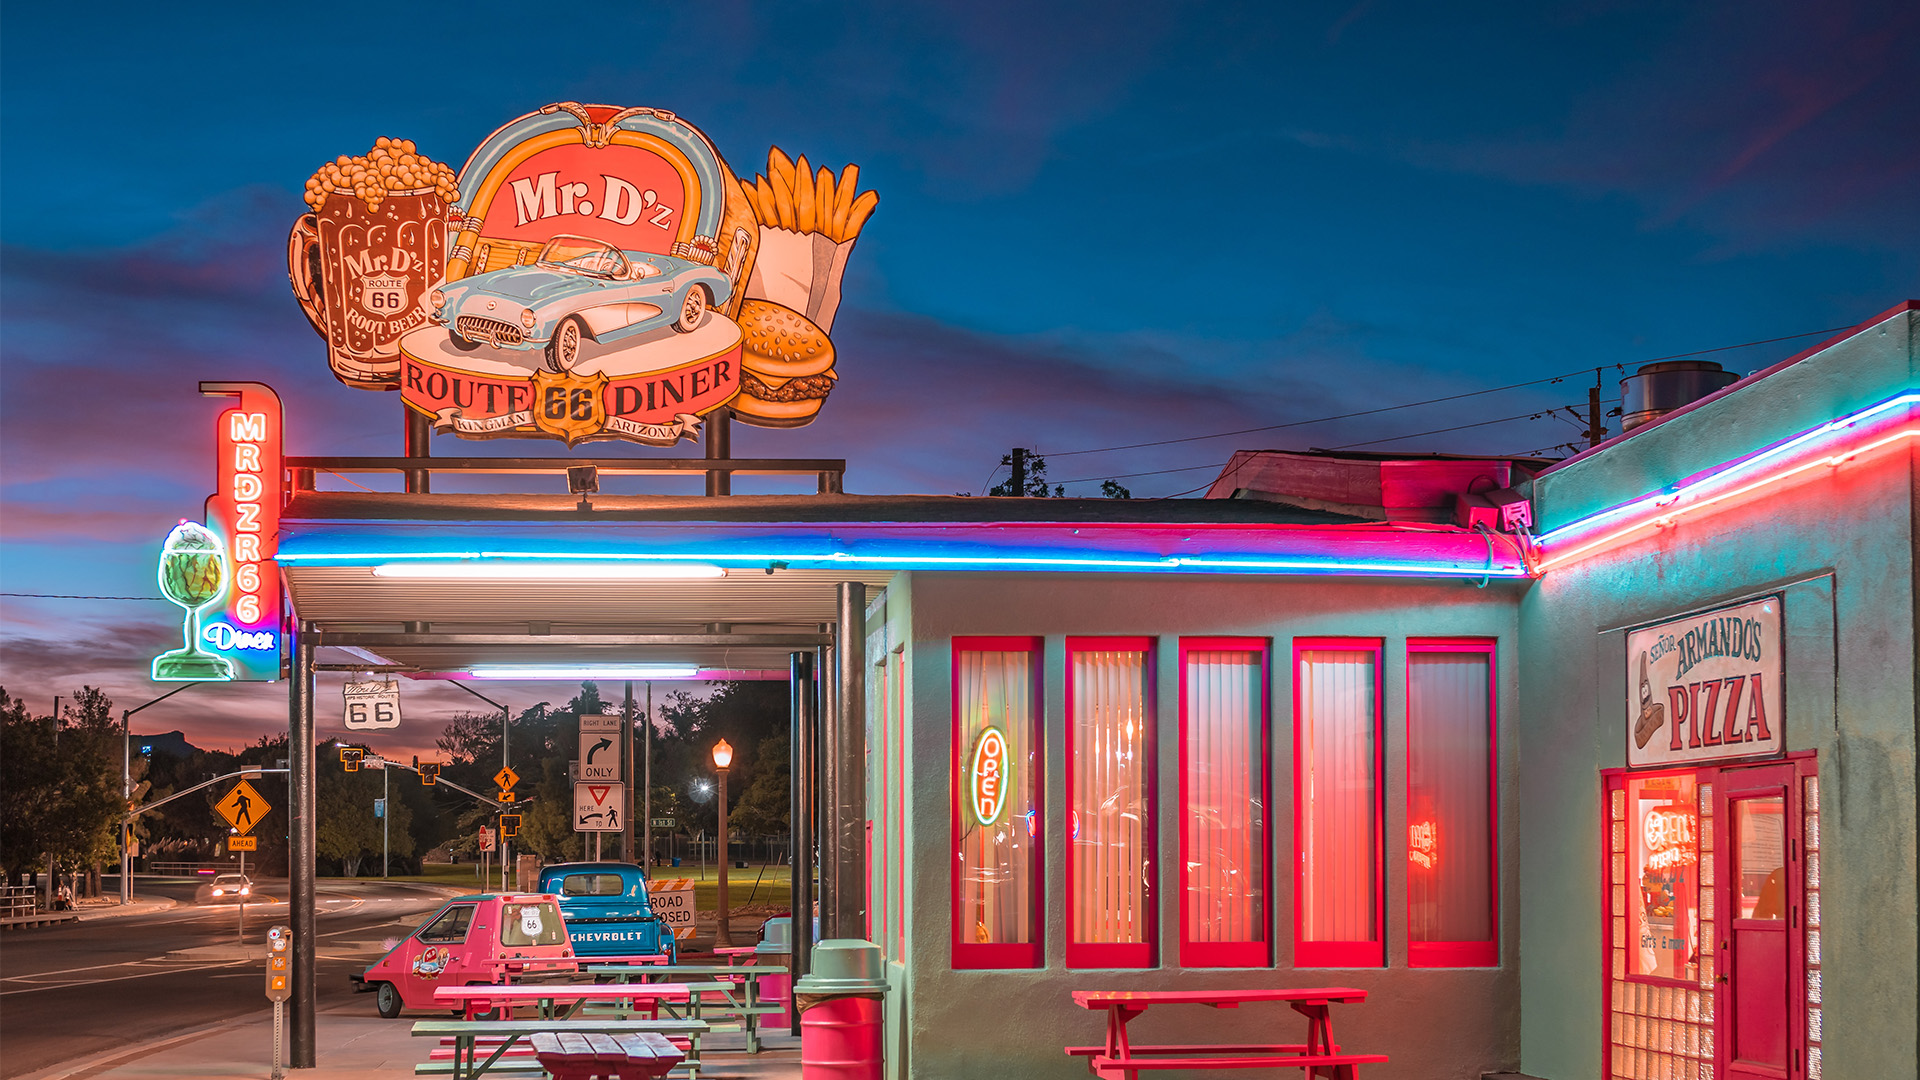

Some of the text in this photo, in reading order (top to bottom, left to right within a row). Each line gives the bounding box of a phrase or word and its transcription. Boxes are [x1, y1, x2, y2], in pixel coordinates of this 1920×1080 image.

[508, 170, 675, 231] Mr. D'z
[343, 246, 424, 280] Mr. D'z
[372, 292, 399, 308] 66
[346, 306, 427, 334] ROOT BEER
[406, 360, 731, 420] ROUTE 66 DINER
[457, 413, 677, 438] KINGMAN ARIZONA
[1650, 616, 1762, 681] SEÑOR ARMANDO'S
[349, 702, 393, 723] 66
[1667, 672, 1772, 751] PIZZA
[586, 767, 613, 777] ONLY
[651, 896, 683, 908] ROAD
[526, 919, 537, 930] 66
[660, 910, 691, 923] OSED
[570, 931, 642, 942] CHEVROLET
